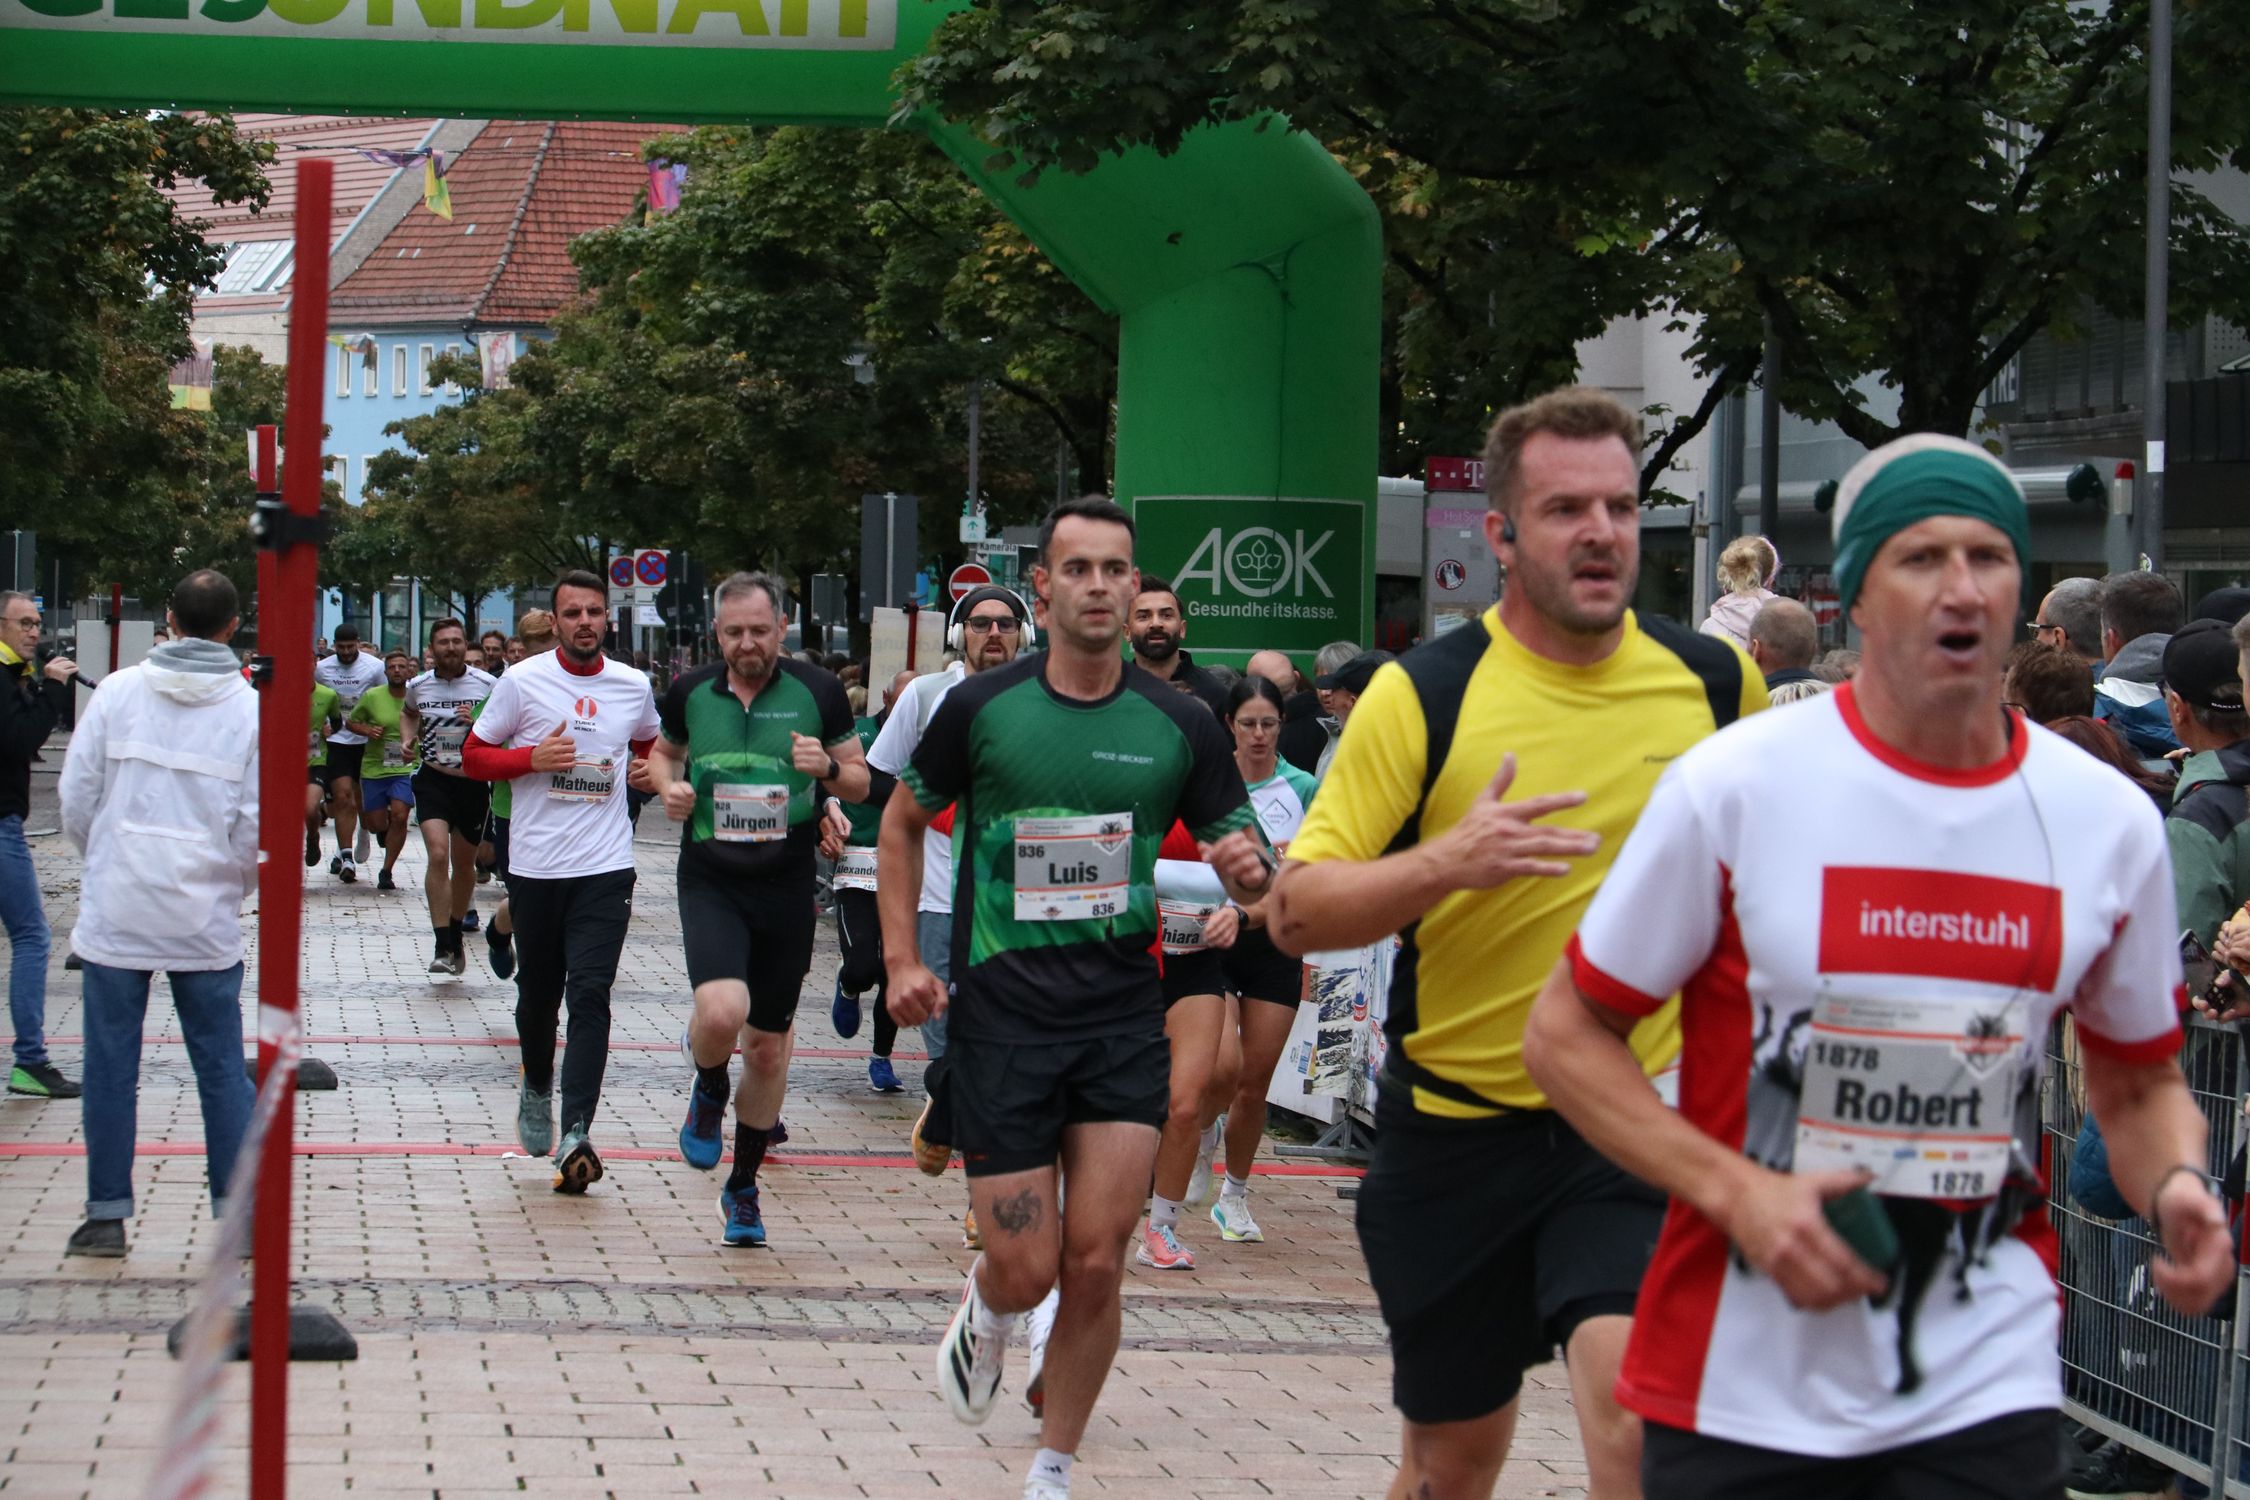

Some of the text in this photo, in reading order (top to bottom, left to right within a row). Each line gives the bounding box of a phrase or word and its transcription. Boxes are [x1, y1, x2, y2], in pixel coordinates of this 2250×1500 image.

[1171, 526, 1335, 599] AOK
[552, 775, 612, 793] Matheus
[721, 813, 777, 833] Jürgen
[1018, 845, 1045, 858] 836
[1049, 861, 1099, 885] Luis
[1092, 902, 1115, 917] 836
[1859, 898, 2029, 951] interstuhl
[1813, 1041, 1880, 1072] 1878
[1834, 1077, 1985, 1129] Robert
[1930, 1170, 1986, 1195] 1878
